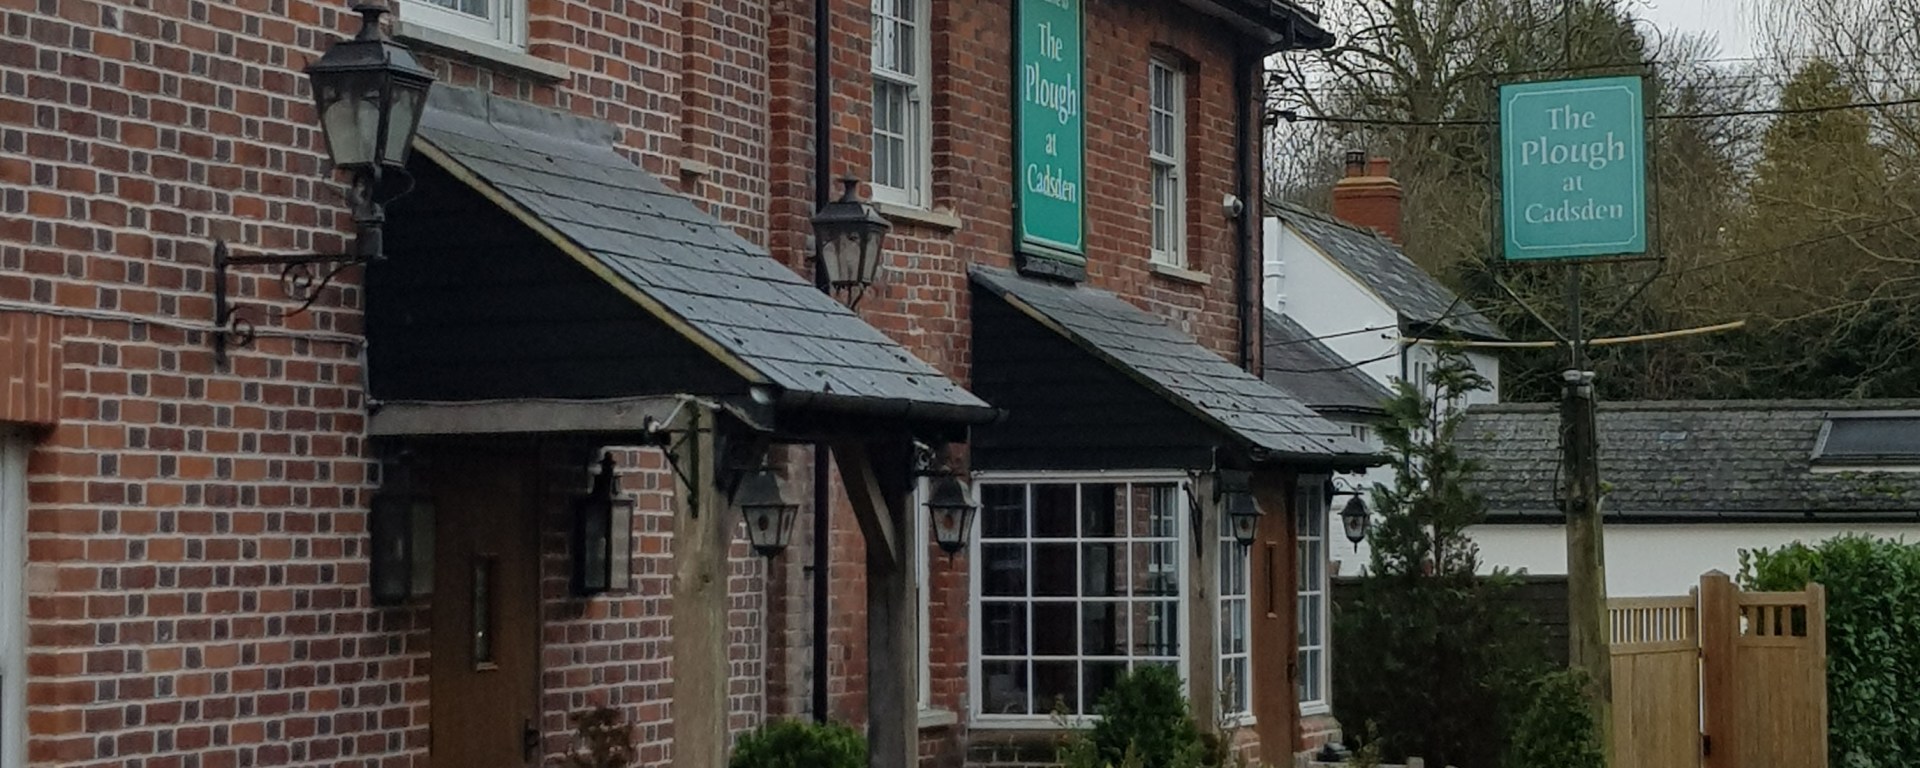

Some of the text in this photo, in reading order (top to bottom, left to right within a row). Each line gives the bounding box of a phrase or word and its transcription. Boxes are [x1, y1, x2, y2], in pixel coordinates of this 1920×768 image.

[1038, 21, 1063, 62] The
[1025, 62, 1077, 125] Plough
[1545, 104, 1596, 131] The
[1045, 132, 1057, 157] at
[1521, 131, 1625, 171] Plough
[1027, 163, 1076, 204] Cadsden
[1562, 175, 1584, 192] at
[1524, 198, 1623, 224] Cadsden
